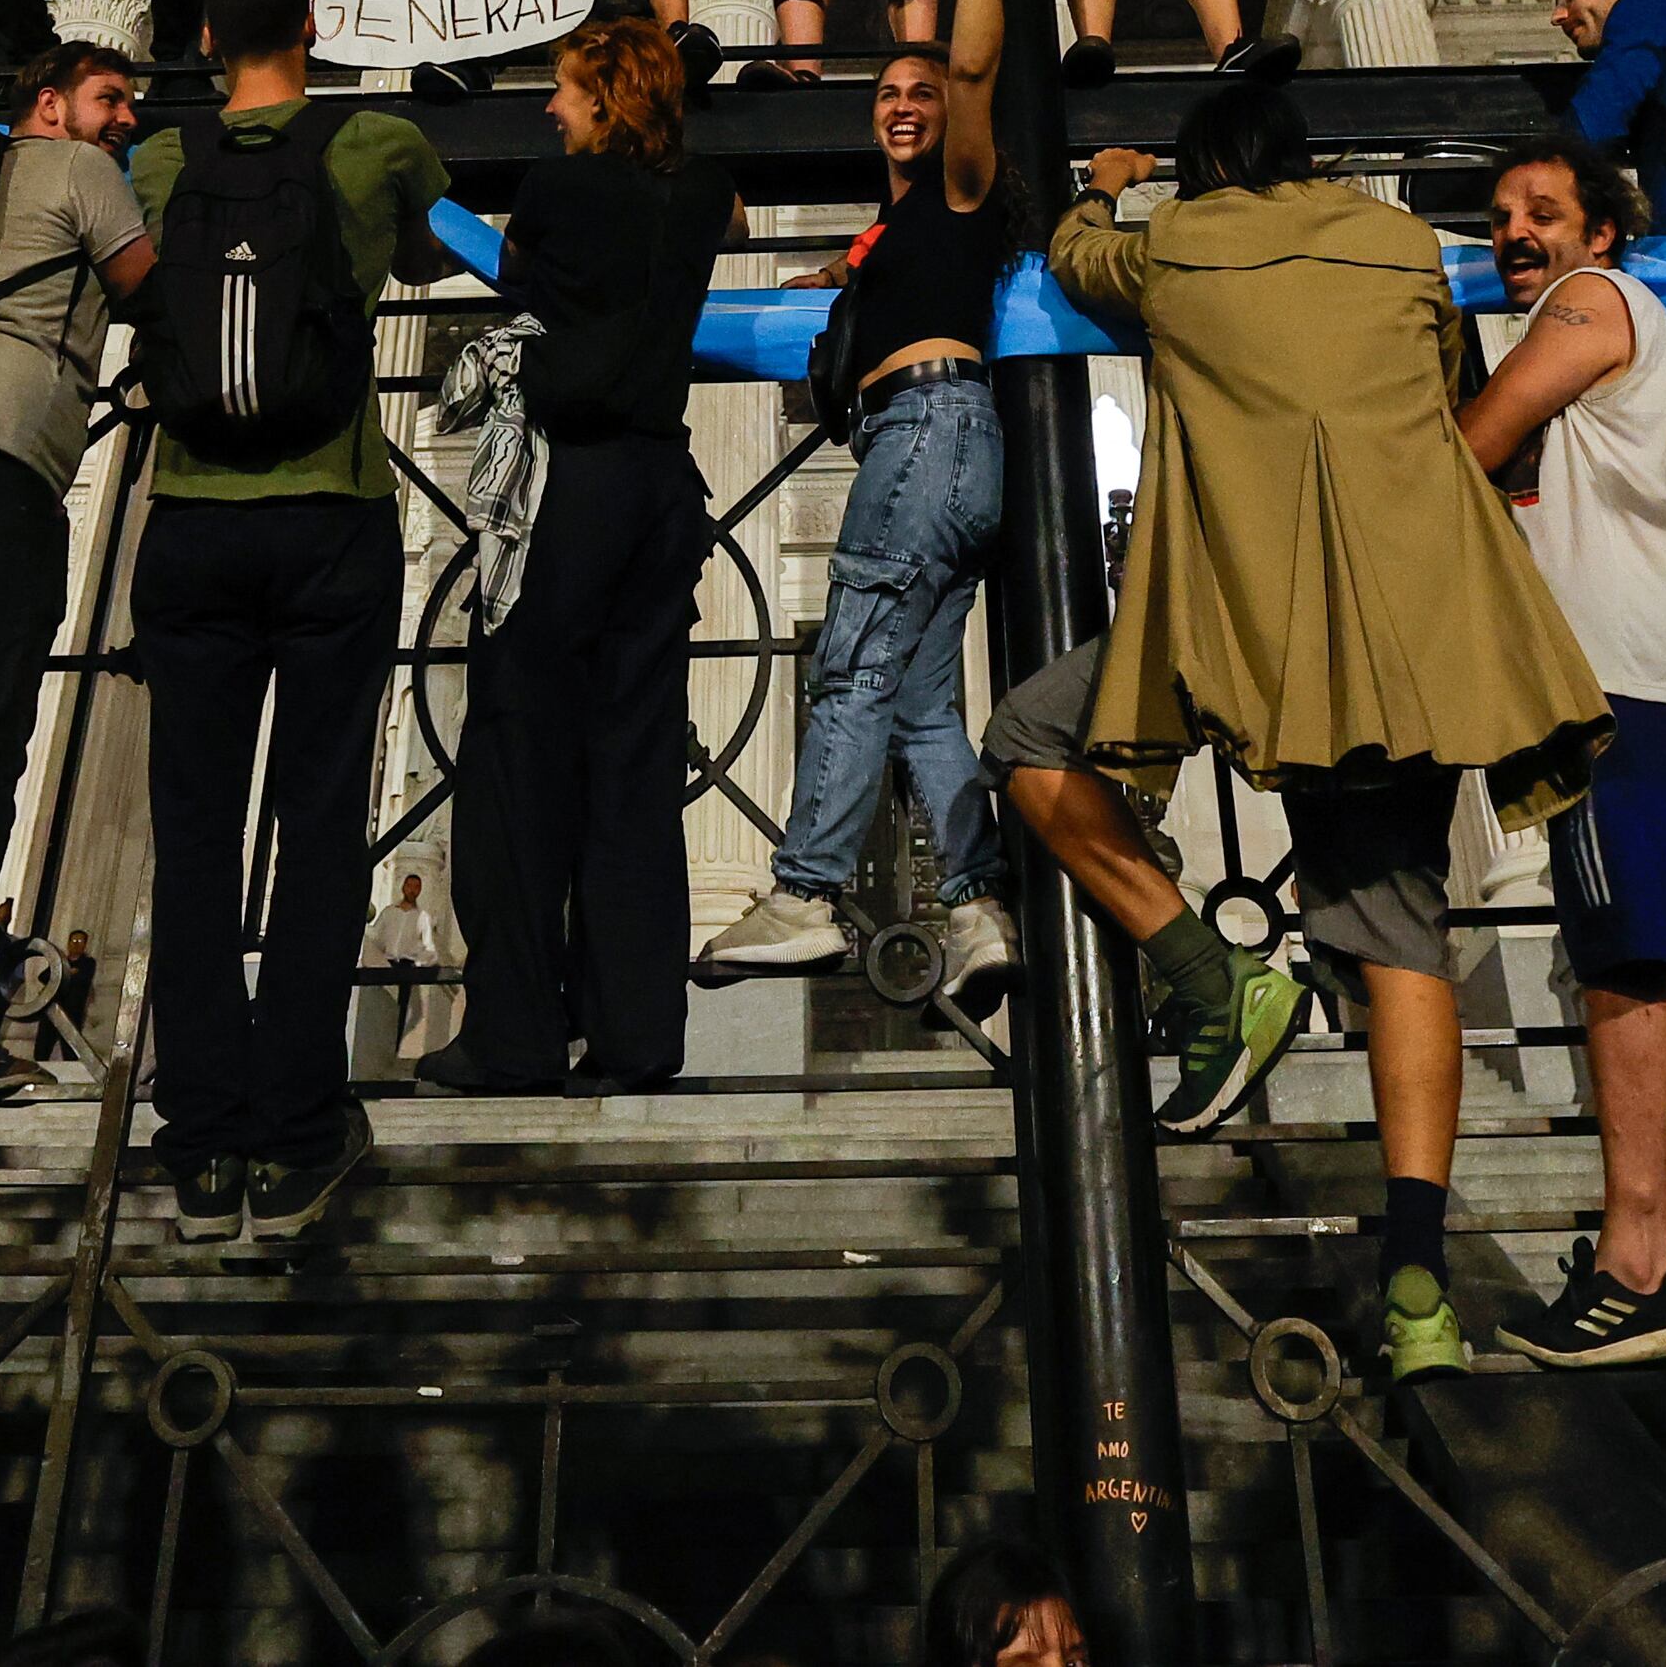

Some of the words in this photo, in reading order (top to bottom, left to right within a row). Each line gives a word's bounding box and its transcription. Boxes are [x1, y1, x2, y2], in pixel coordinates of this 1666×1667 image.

[225, 252, 257, 261] adidas
[1103, 1402, 1126, 1422] TE
[1097, 1440, 1130, 1460] AMO
